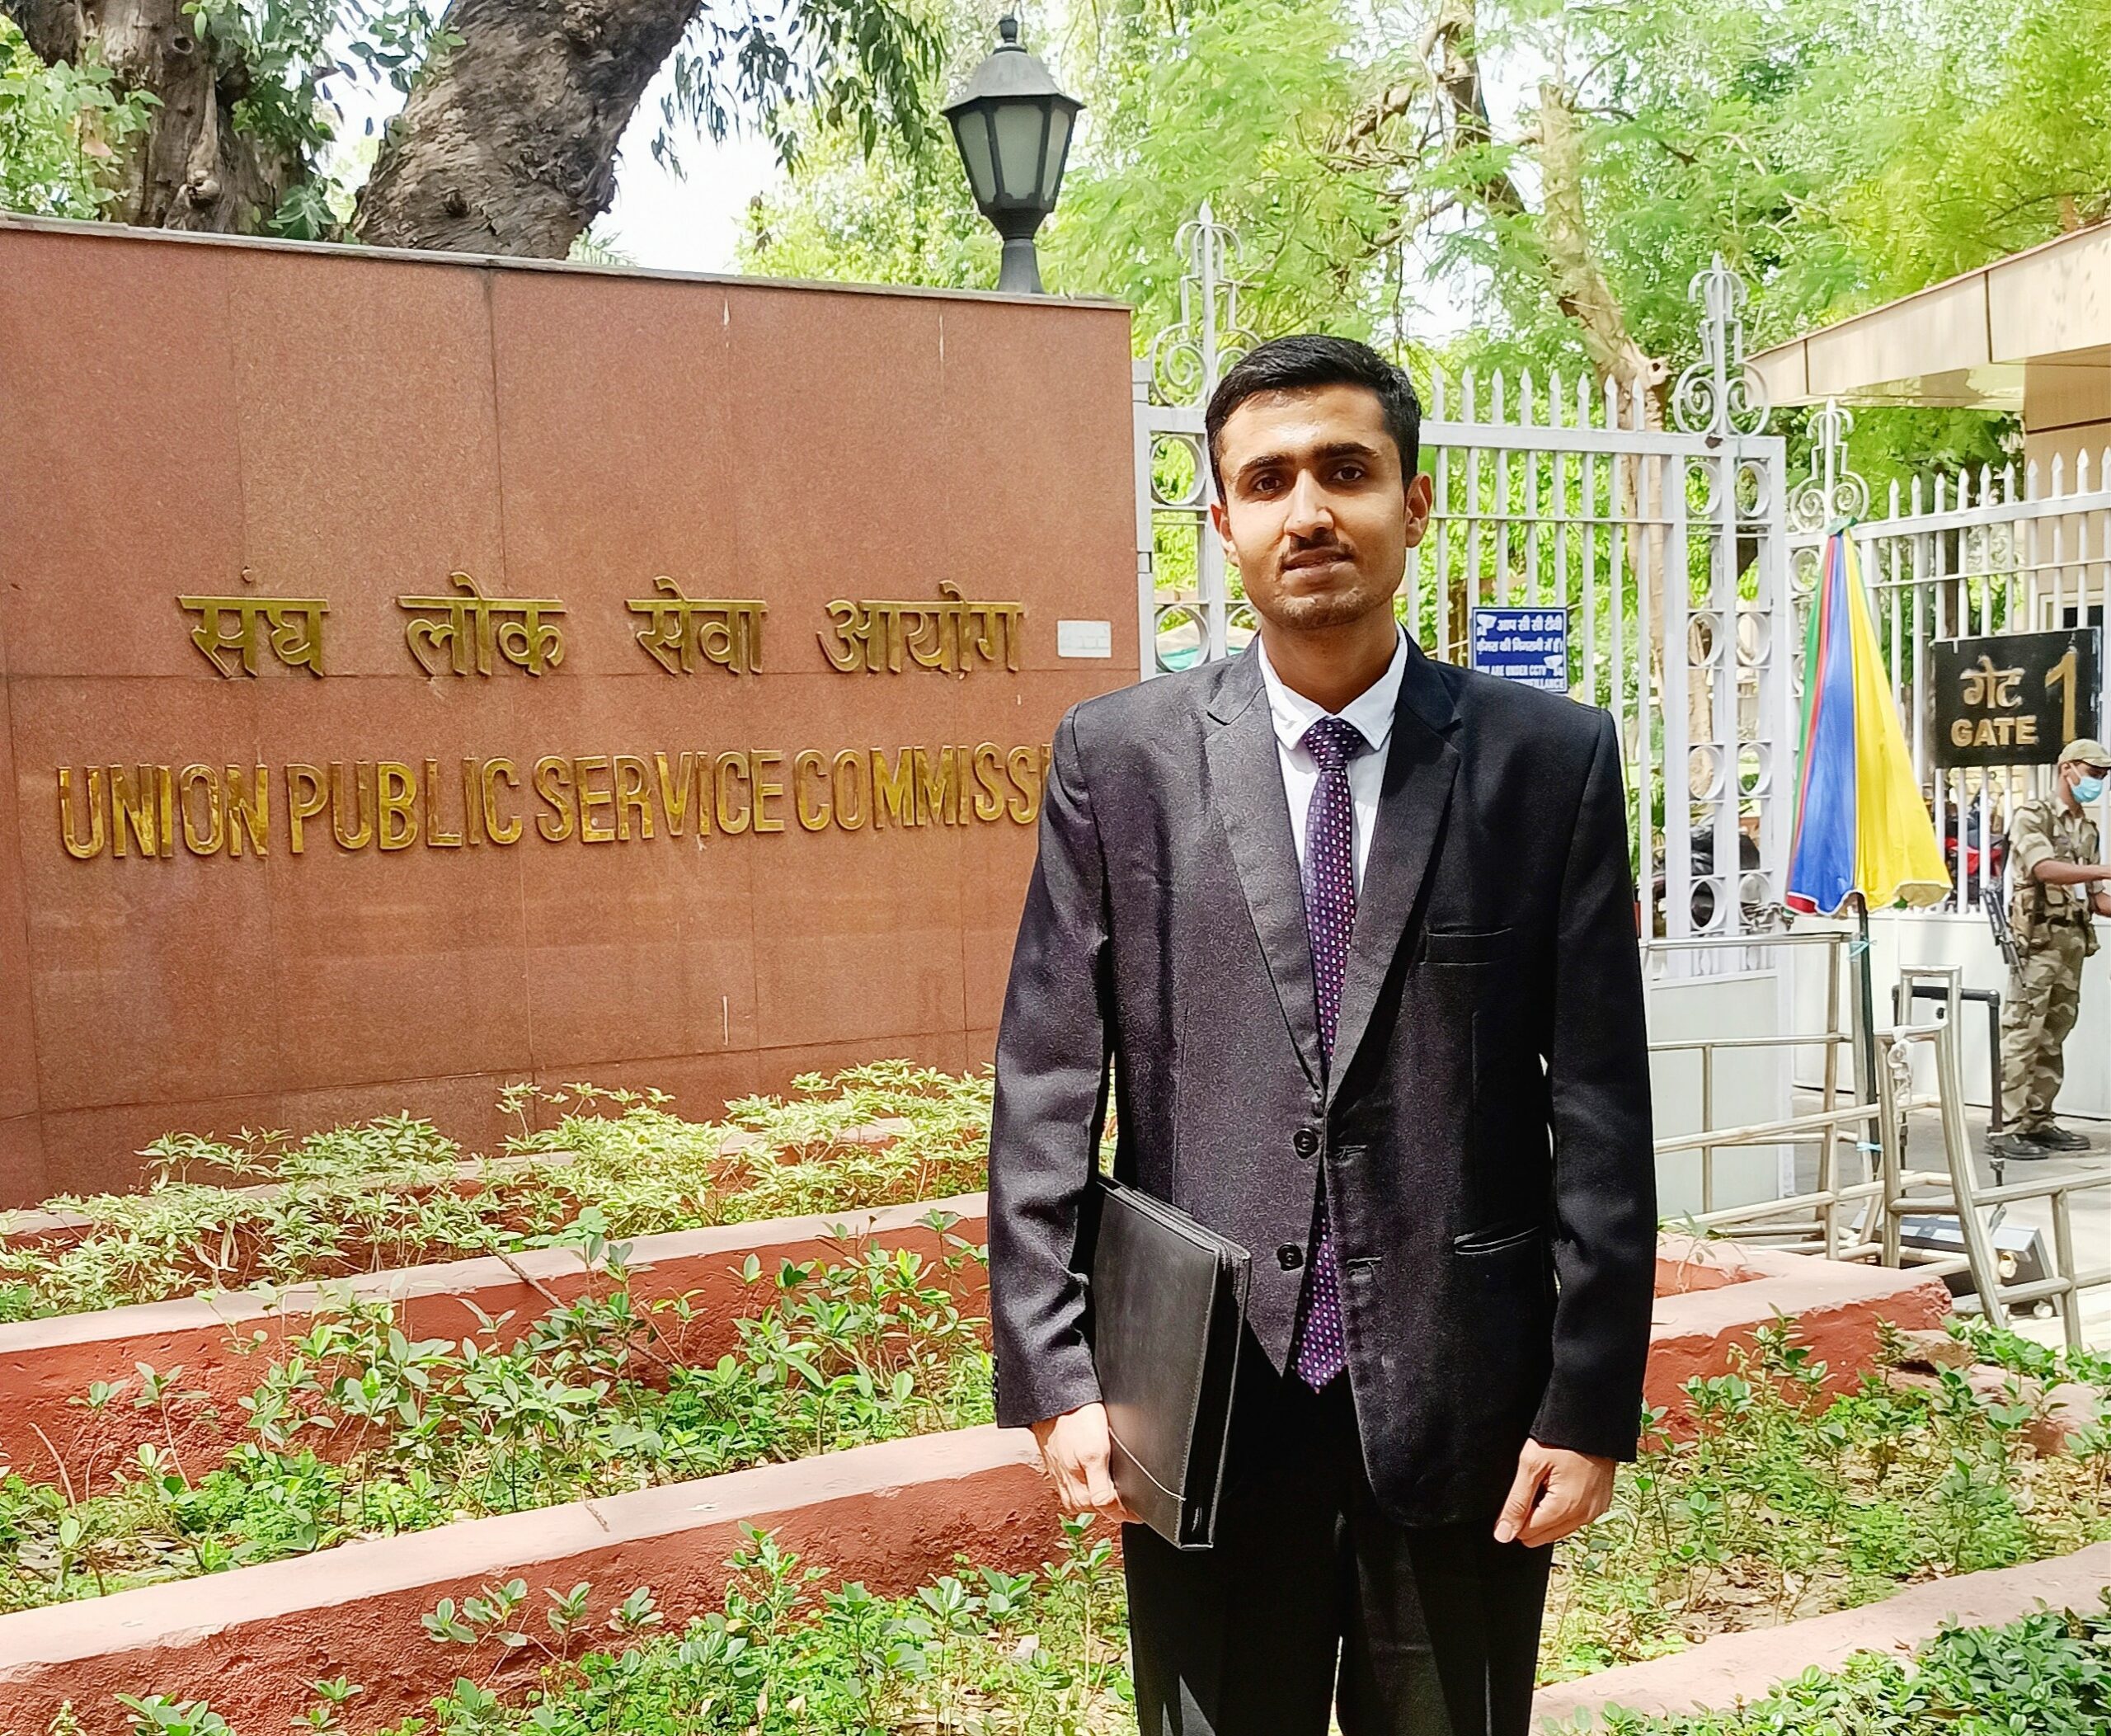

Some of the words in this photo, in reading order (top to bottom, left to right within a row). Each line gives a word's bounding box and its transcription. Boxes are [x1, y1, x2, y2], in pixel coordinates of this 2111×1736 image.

[176, 566, 330, 678] संघ
[396, 572, 567, 677] लोक
[625, 576, 769, 675] सेवा
[816, 580, 1025, 675] आयोग
[1530, 665, 1546, 676] CCTV
[1959, 655, 2025, 708] गेट
[2044, 650, 2077, 744] 1
[1950, 715, 2040, 747] GATE
[57, 762, 270, 859] UNION
[284, 756, 524, 854] PUBLIC
[534, 749, 786, 844] SERVICE
